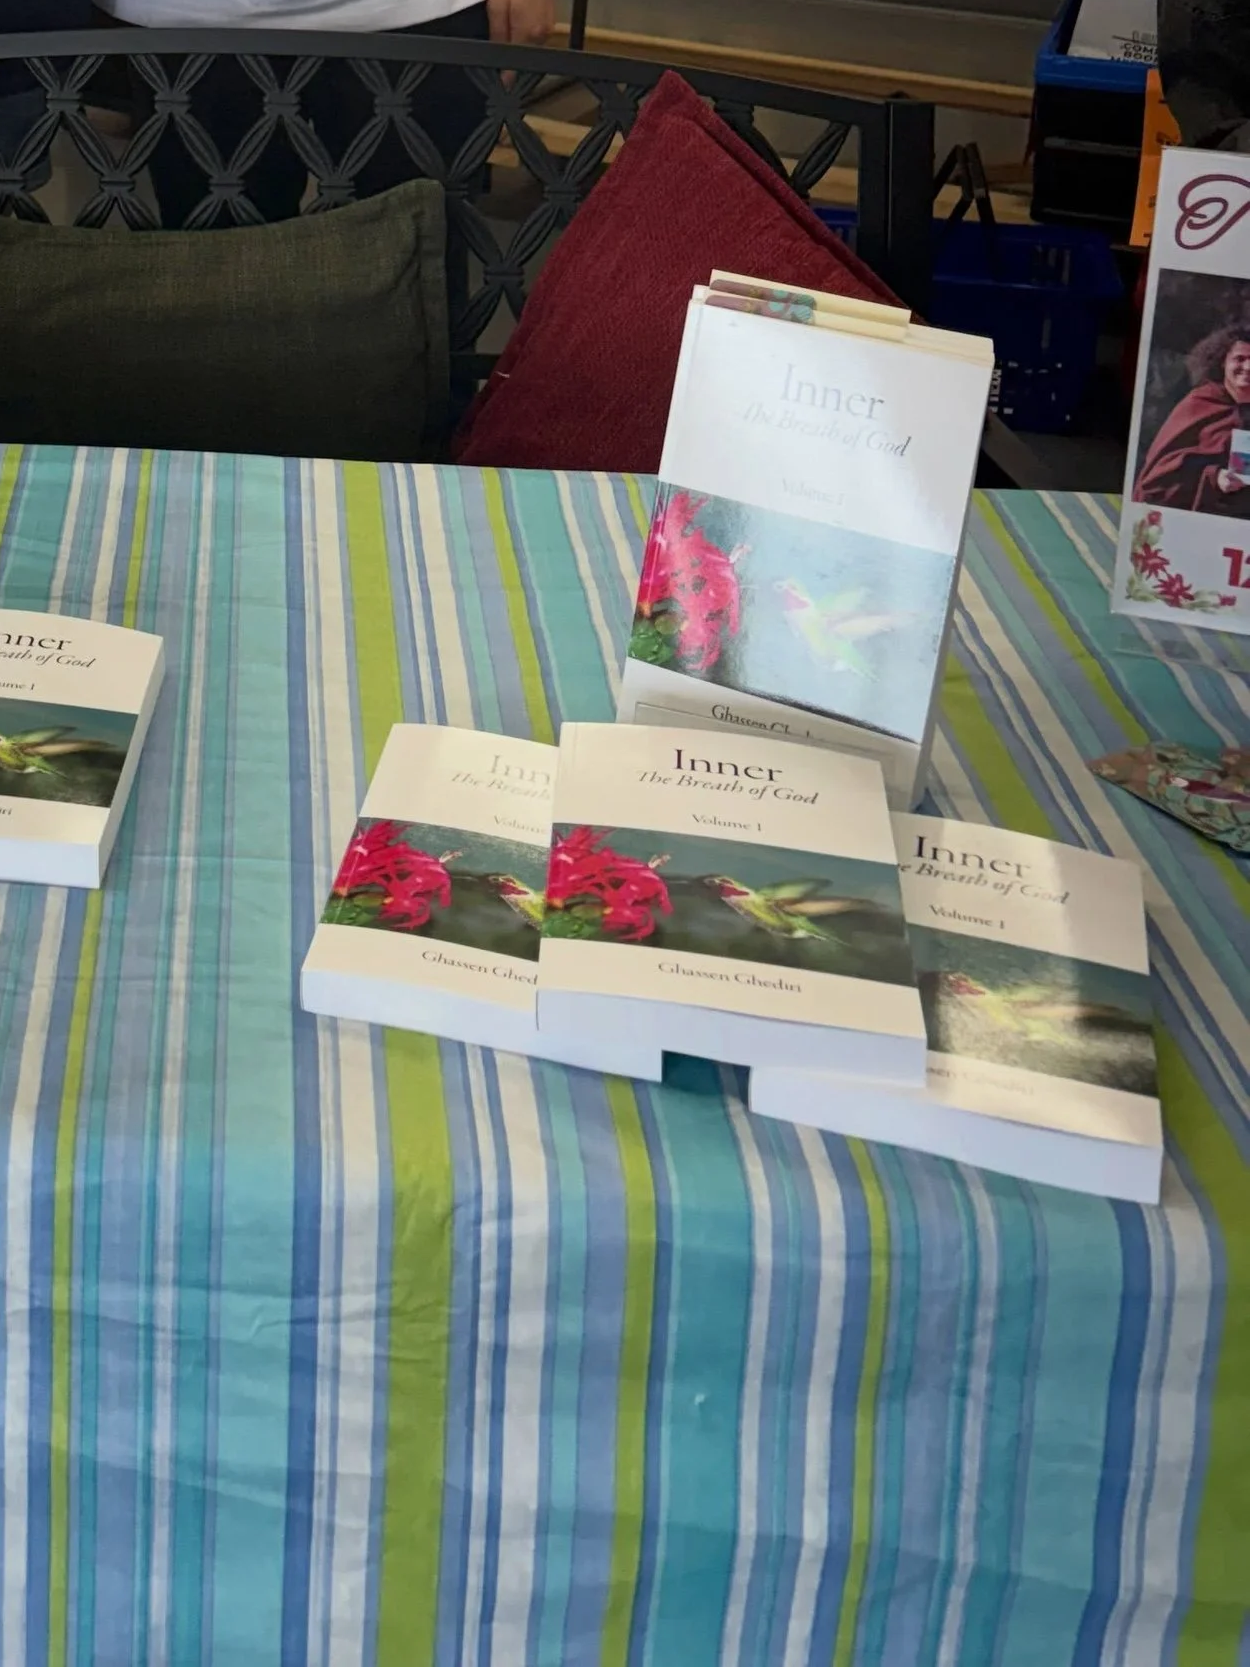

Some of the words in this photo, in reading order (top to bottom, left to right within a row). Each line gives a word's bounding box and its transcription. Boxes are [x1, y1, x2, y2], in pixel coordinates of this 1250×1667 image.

[779, 361, 885, 422] Inner
[776, 407, 839, 444] Breath
[866, 426, 912, 457] God
[36, 649, 54, 666] of
[55, 653, 96, 669] God
[673, 748, 783, 783] Inner
[637, 770, 672, 786] The
[676, 774, 744, 794] Breath
[747, 783, 773, 801] of
[774, 786, 820, 806] God
[691, 813, 751, 831] Volume
[914, 835, 1031, 879] Inner
[915, 863, 989, 888] Breath
[992, 880, 1017, 896] of
[1020, 883, 1071, 906] God
[929, 904, 993, 928] Volume
[421, 950, 488, 974] Ghassen
[658, 962, 730, 983] Ghassen
